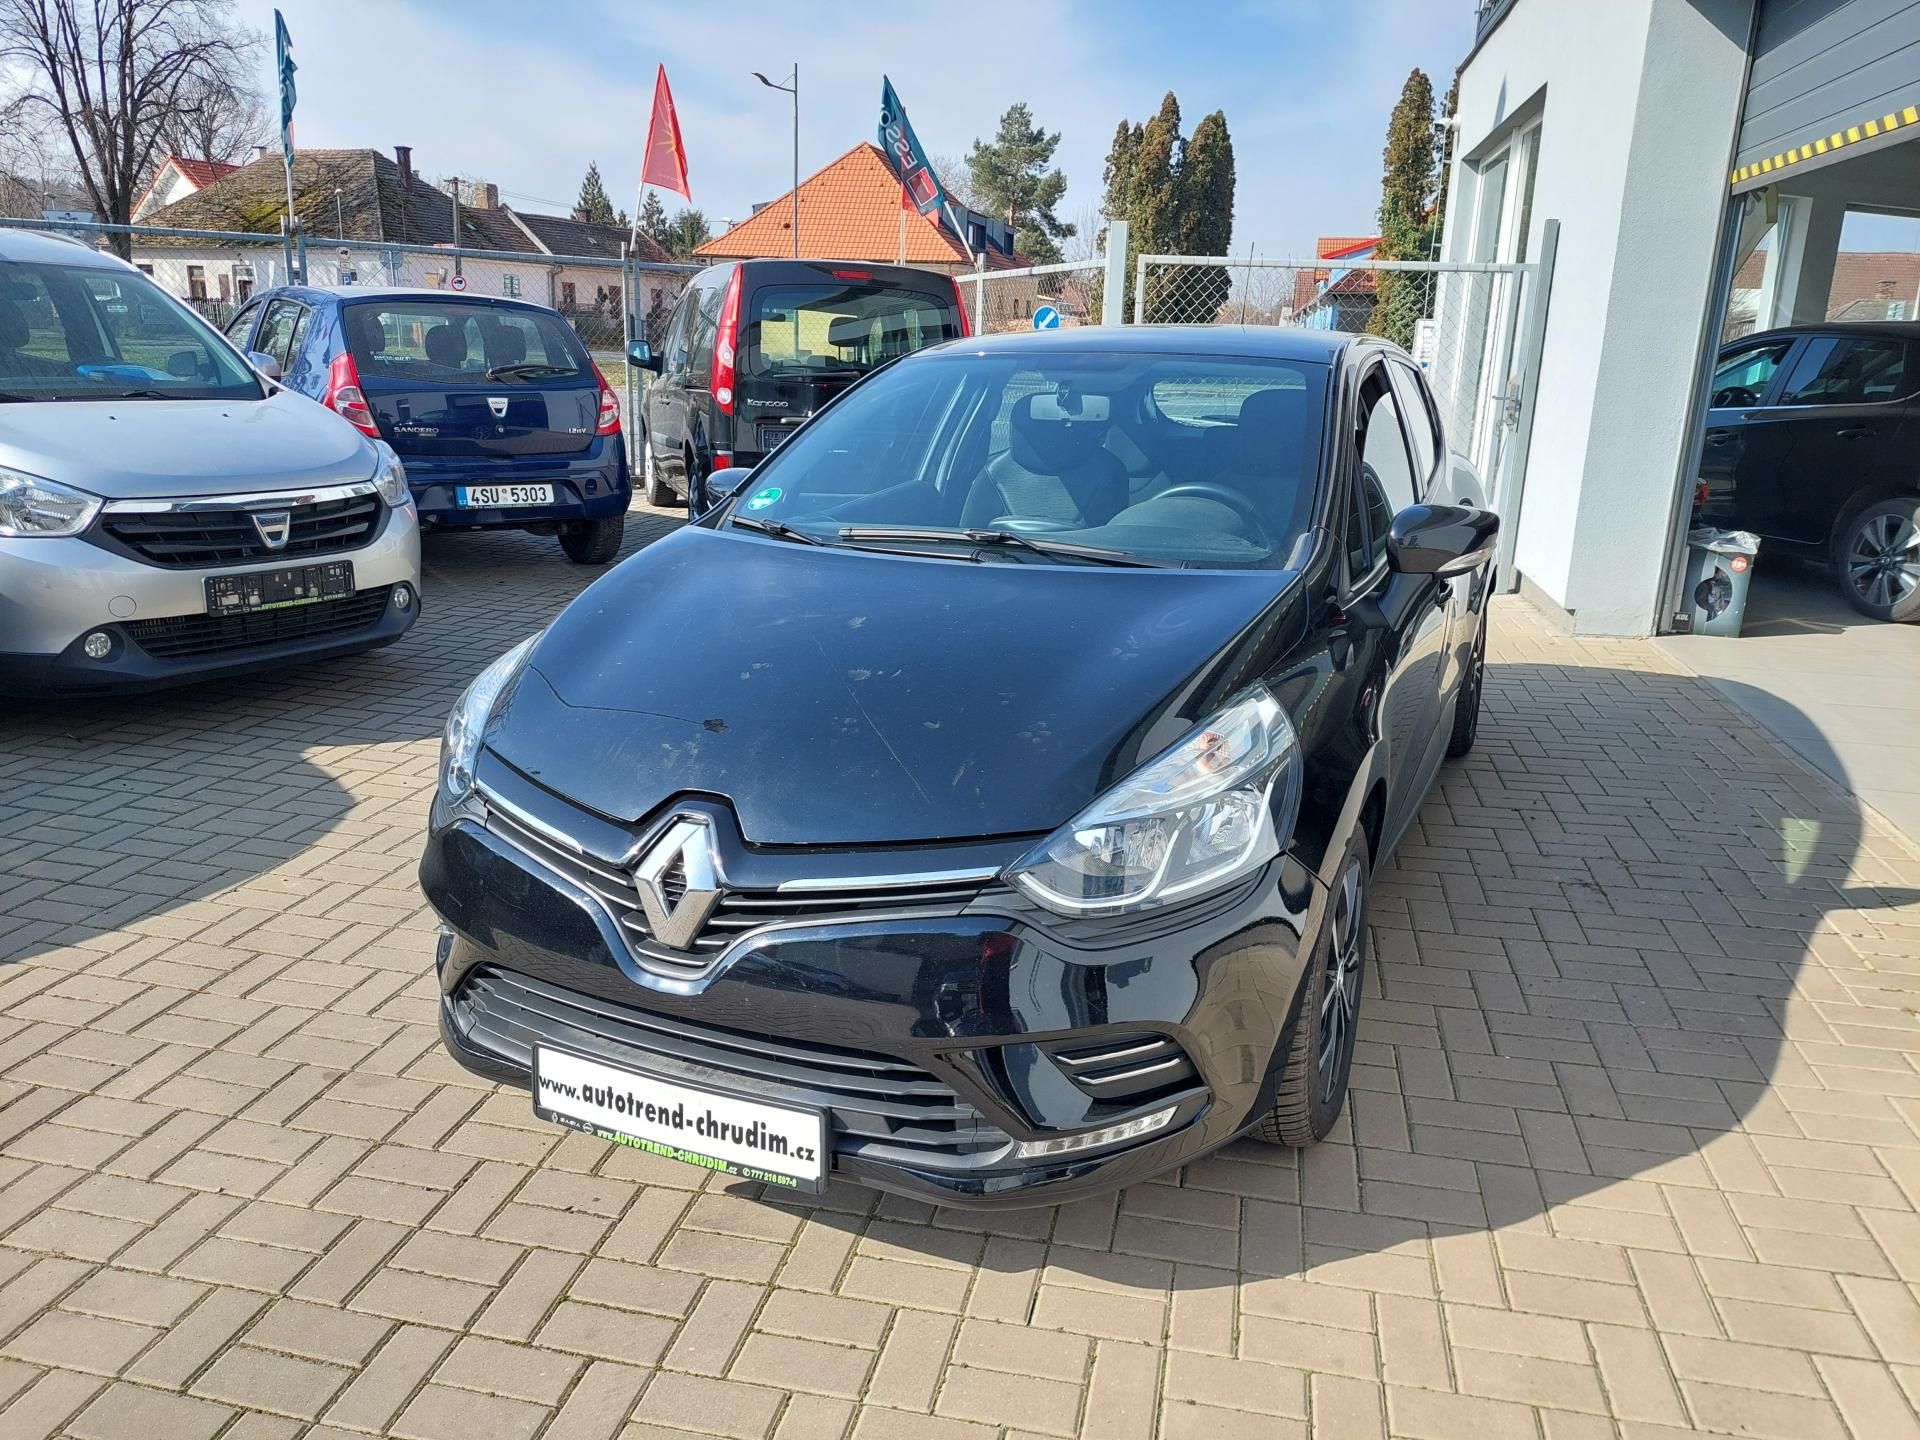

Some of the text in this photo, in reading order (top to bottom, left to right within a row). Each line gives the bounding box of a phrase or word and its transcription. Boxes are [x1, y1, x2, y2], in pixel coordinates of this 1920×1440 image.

[393, 426, 440, 434] SANDERO
[471, 487, 547, 504] 4SU 5303
[538, 1075, 815, 1162] www.autotrend-chrudim.cz
[751, 1169, 764, 1180] 777
